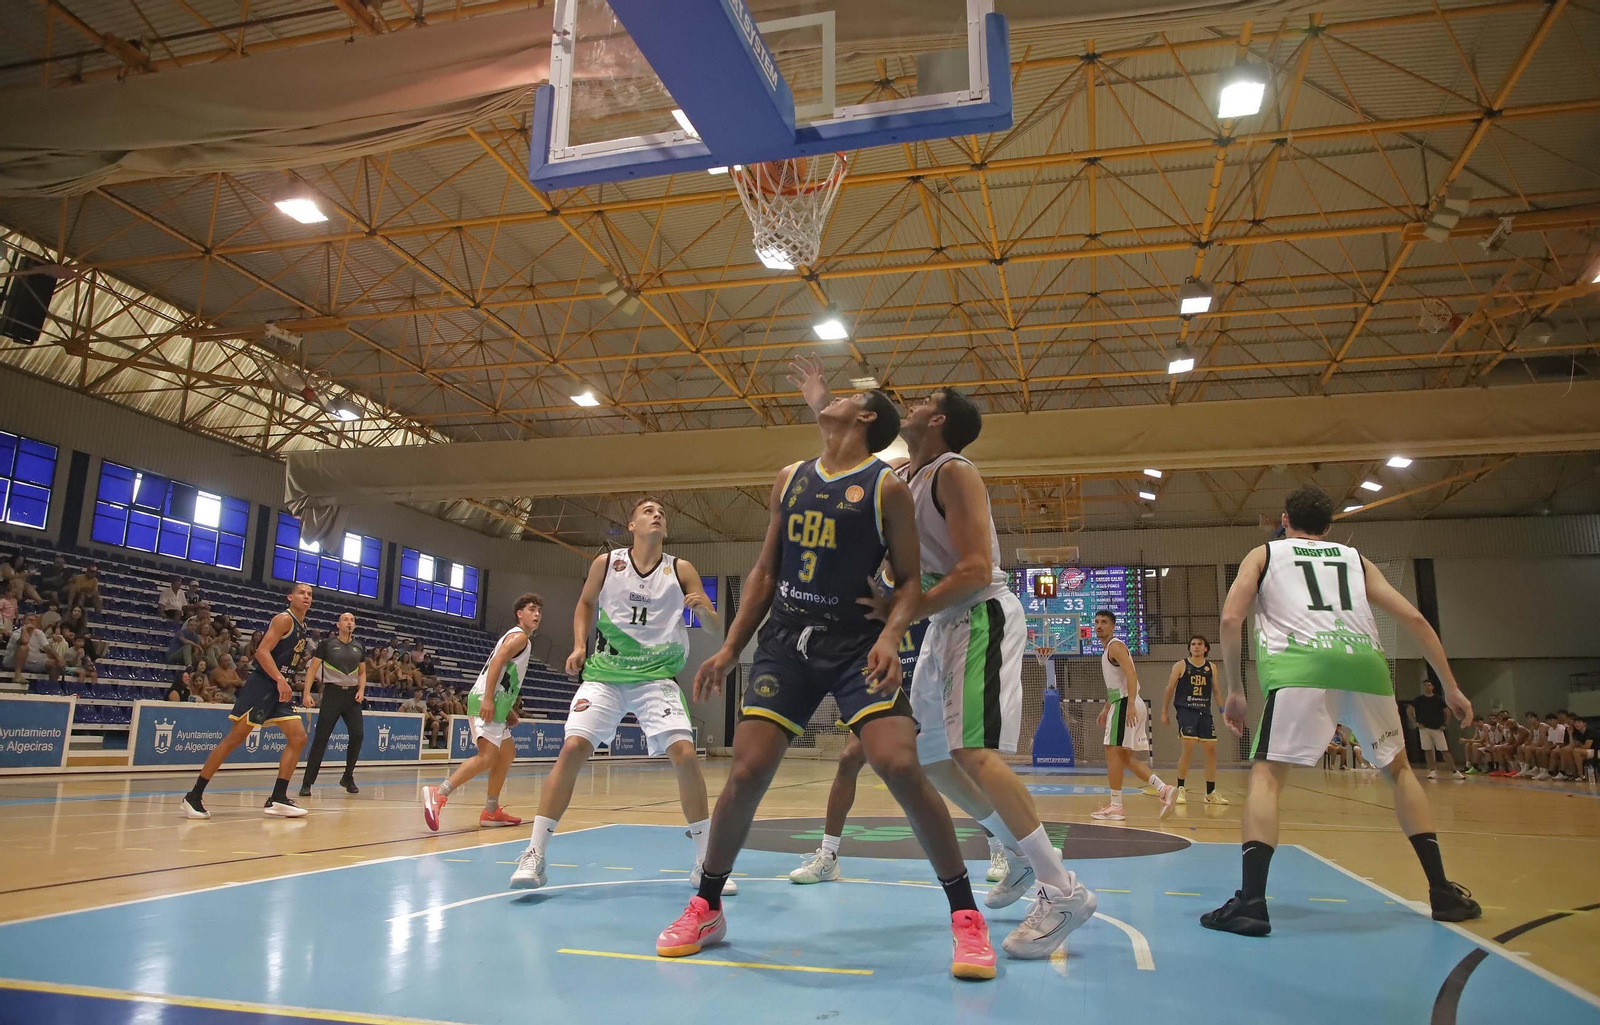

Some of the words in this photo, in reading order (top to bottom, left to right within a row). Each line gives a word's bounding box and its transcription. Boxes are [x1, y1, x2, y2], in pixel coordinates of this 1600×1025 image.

[788, 510, 838, 549] CBA
[798, 550, 818, 584] 3
[1294, 560, 1353, 612] 17
[790, 586, 838, 605] damex.io
[1063, 598, 1084, 610] 33
[630, 606, 647, 625] 14
[1190, 675, 1207, 685] CBA
[1193, 687, 1203, 696] 21
[176, 730, 223, 741] Ayuntamiento
[391, 734, 419, 743] Ayuntamiento
[7, 741, 54, 754] Algeciras
[184, 742, 217, 753] Algeciras
[396, 742, 416, 751] Algeciras
